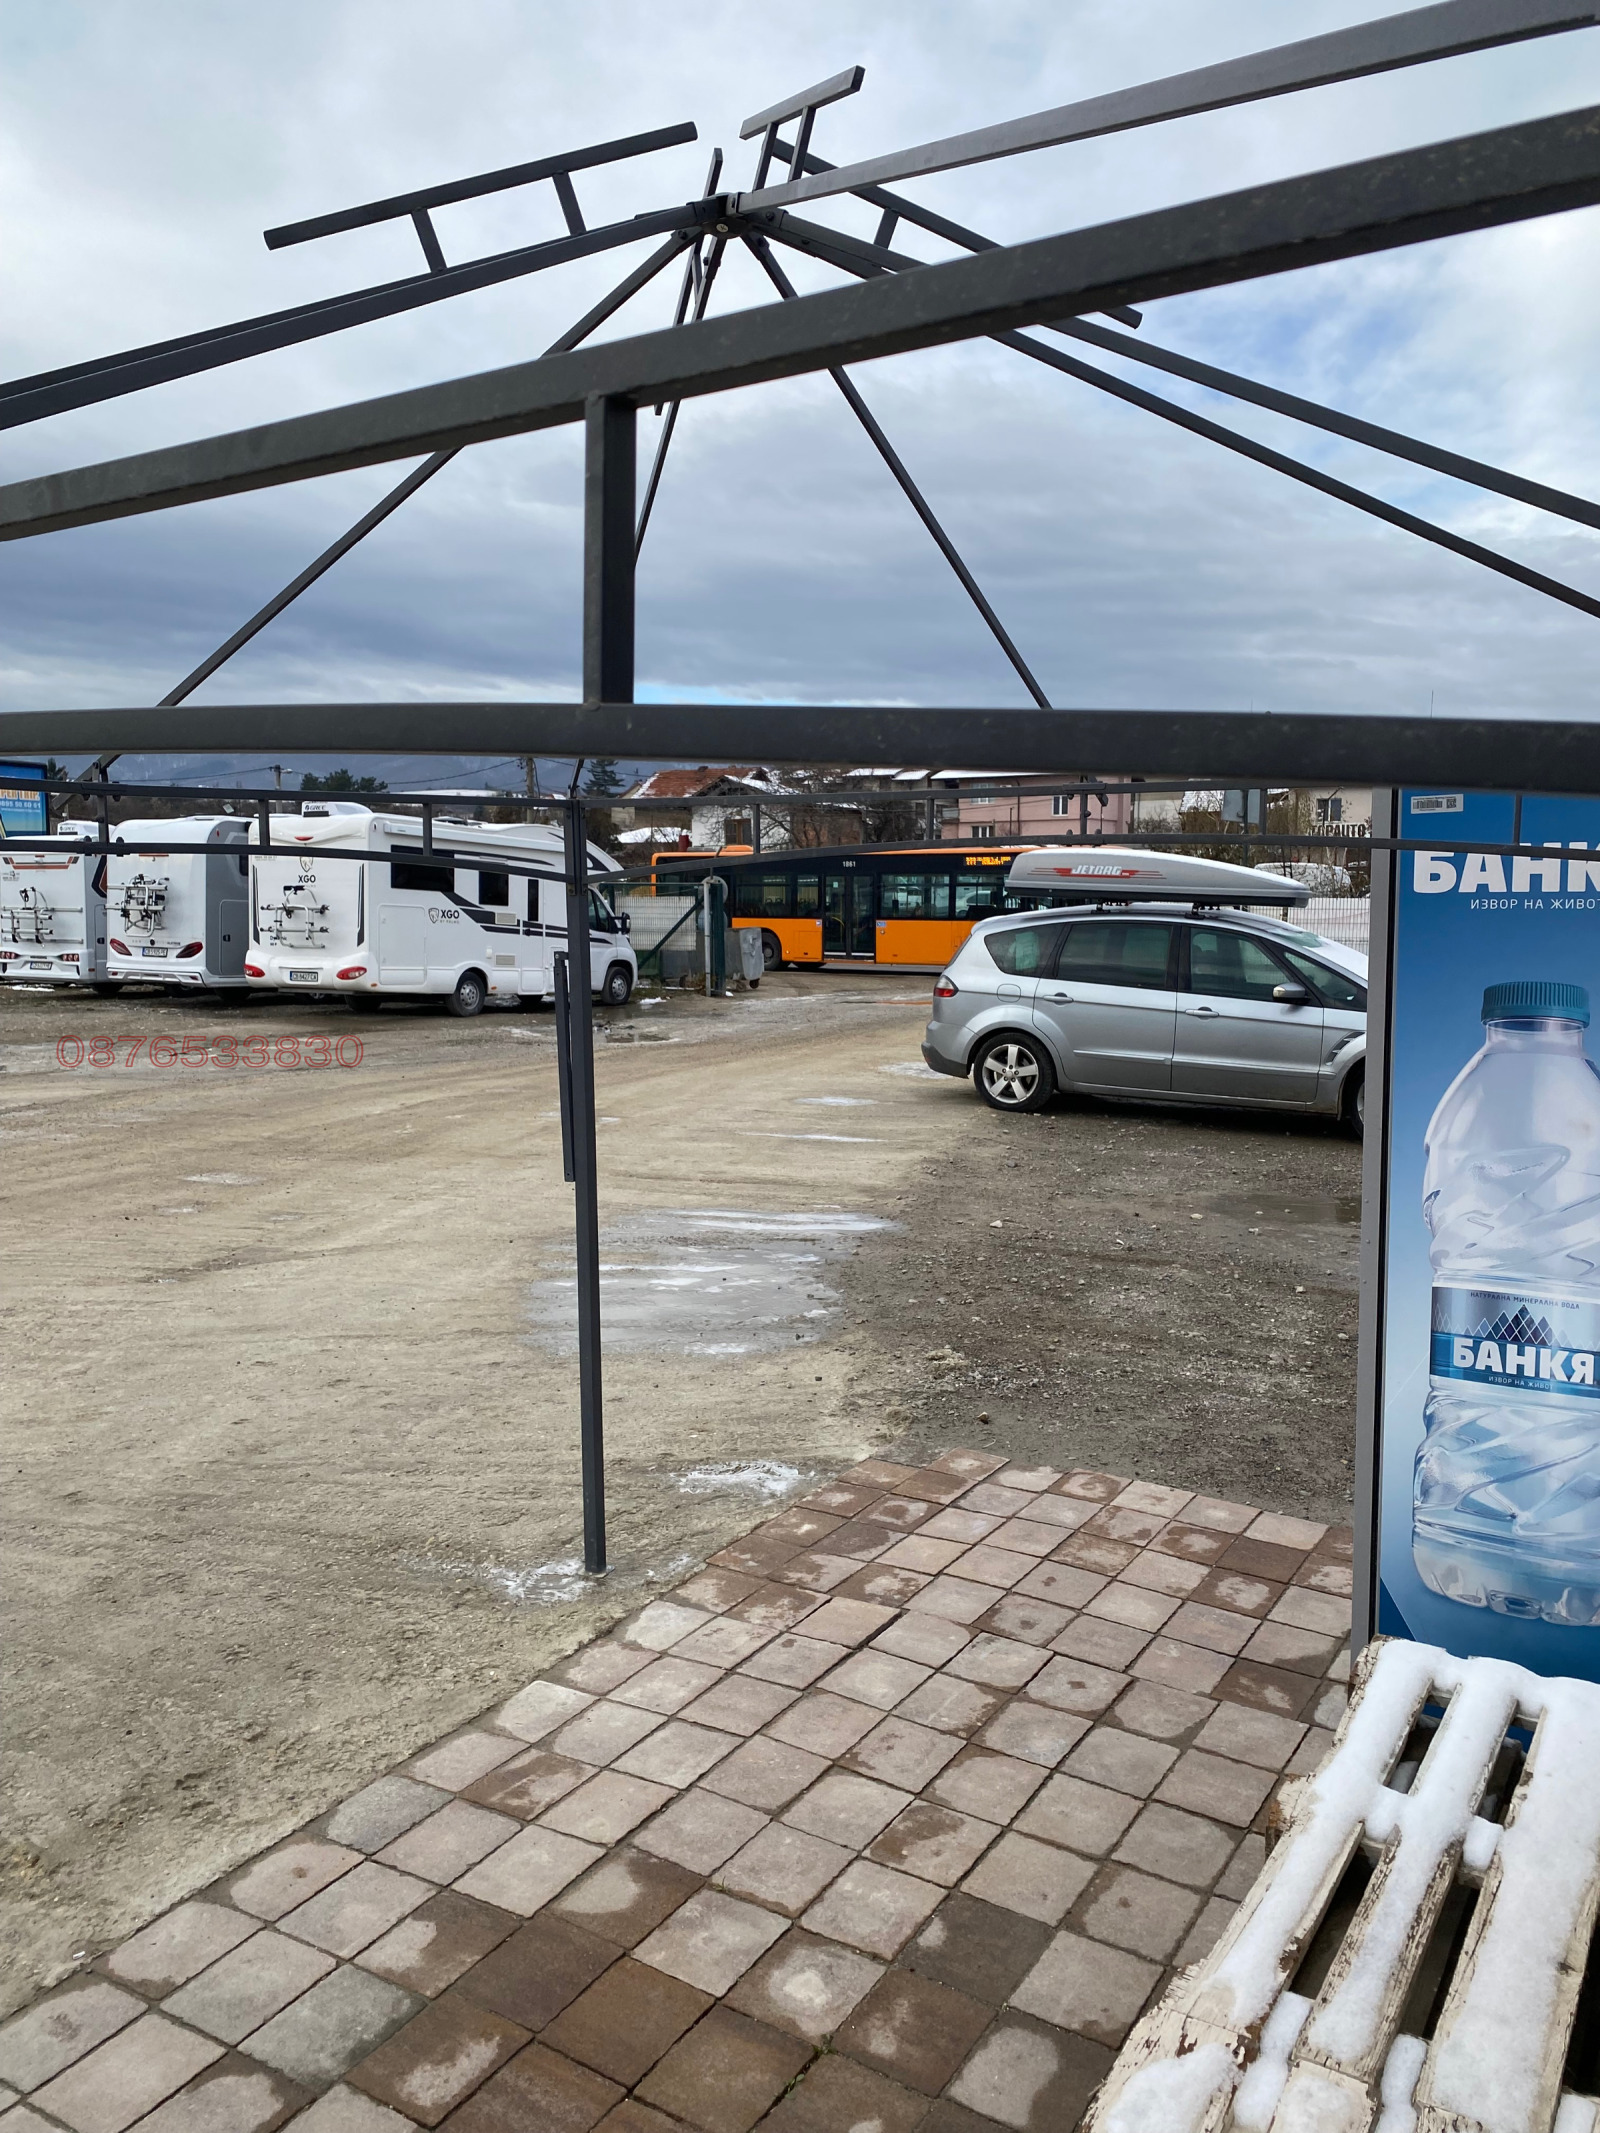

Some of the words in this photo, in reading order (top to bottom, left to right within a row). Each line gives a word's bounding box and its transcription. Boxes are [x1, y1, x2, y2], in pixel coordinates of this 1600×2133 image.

[1071, 864, 1122, 876] JETBAG
[298, 874, 316, 884] XGO
[1470, 898, 1518, 910] ИЗВОР
[1524, 898, 1544, 910] НА
[440, 909, 460, 919] XGO
[1470, 1291, 1511, 1302] НАТУРАЛНА
[1513, 1296, 1559, 1307] МИНЕРАЛНА
[1561, 1302, 1580, 1310] ВОДА
[1453, 1336, 1595, 1385] БАНКЯ
[1488, 1375, 1513, 1385] ИЗВОР
[1514, 1379, 1525, 1387] НА
[1527, 1381, 1553, 1390] ЖИВОТ
